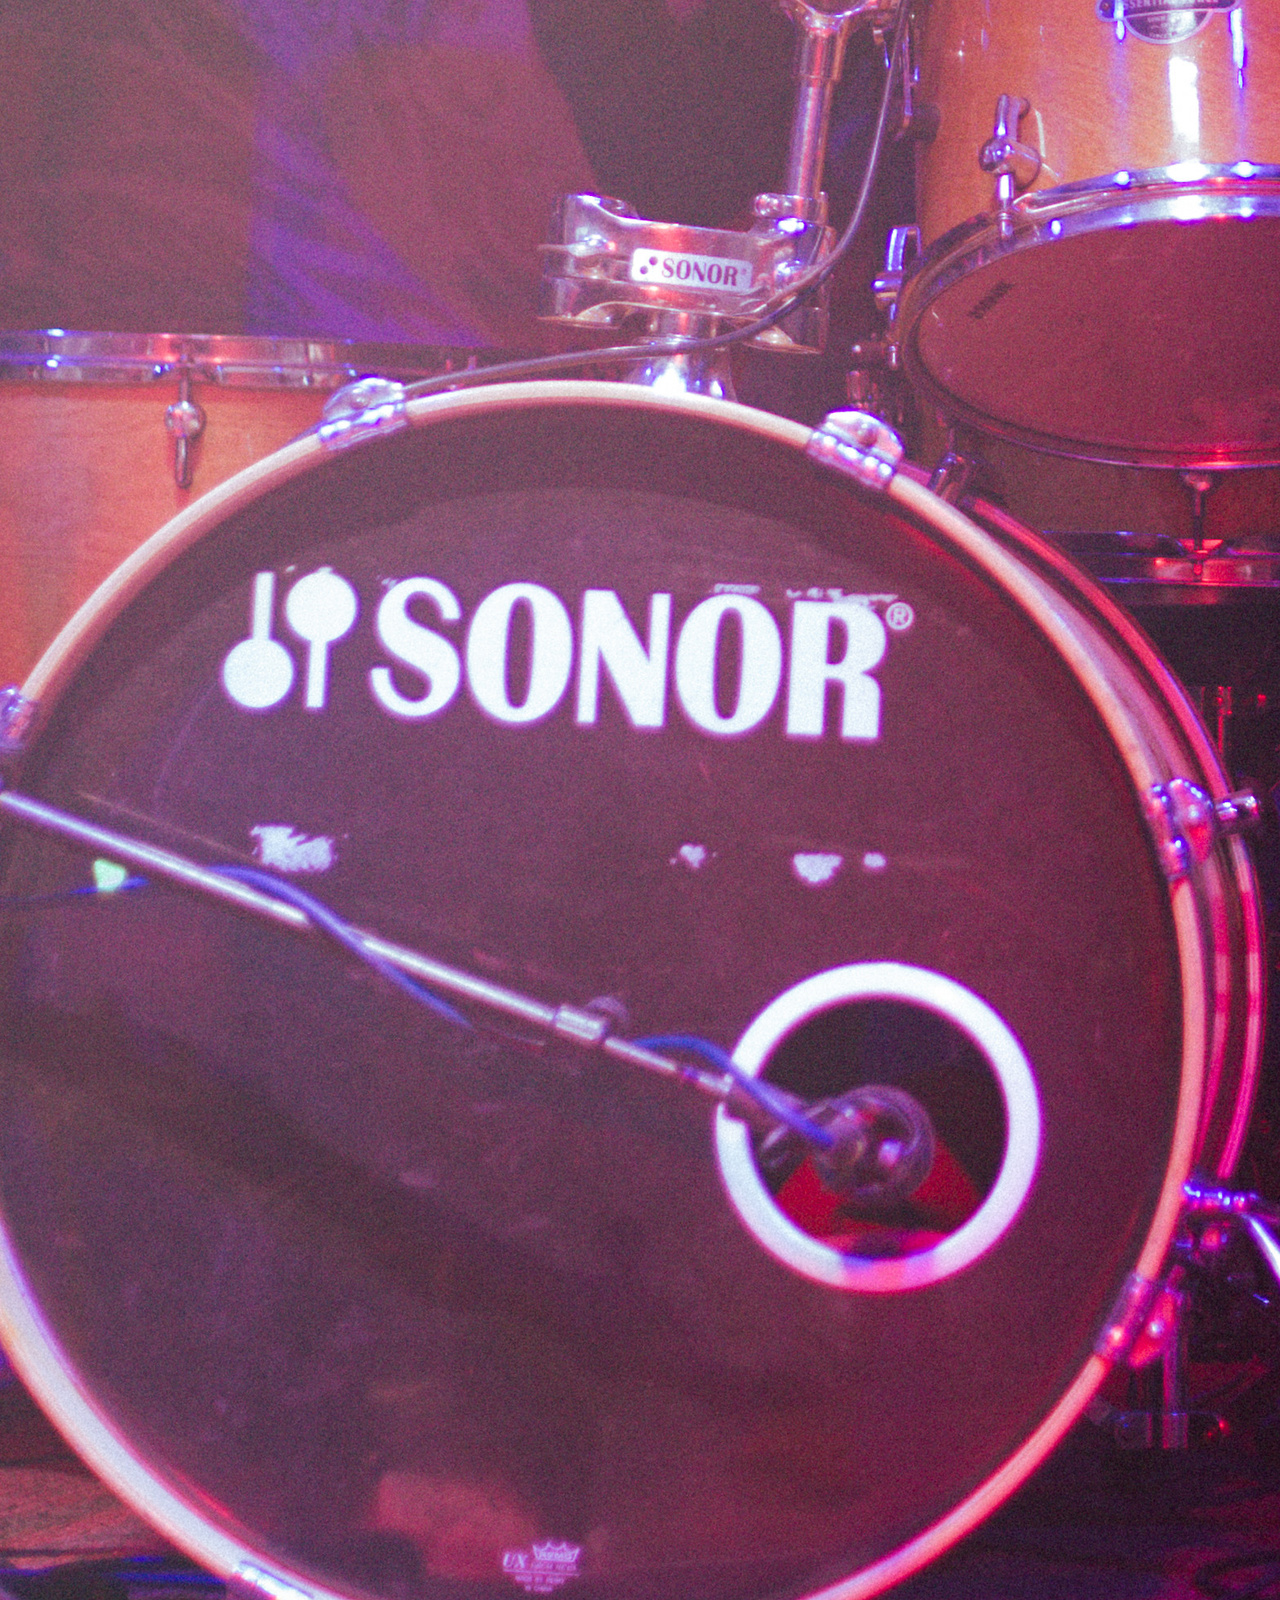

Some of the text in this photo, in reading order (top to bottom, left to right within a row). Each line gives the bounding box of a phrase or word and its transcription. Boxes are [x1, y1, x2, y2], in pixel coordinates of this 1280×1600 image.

[661, 258, 739, 287] SONOR
[369, 576, 889, 740] SONOR
[502, 1552, 529, 1569] UX
